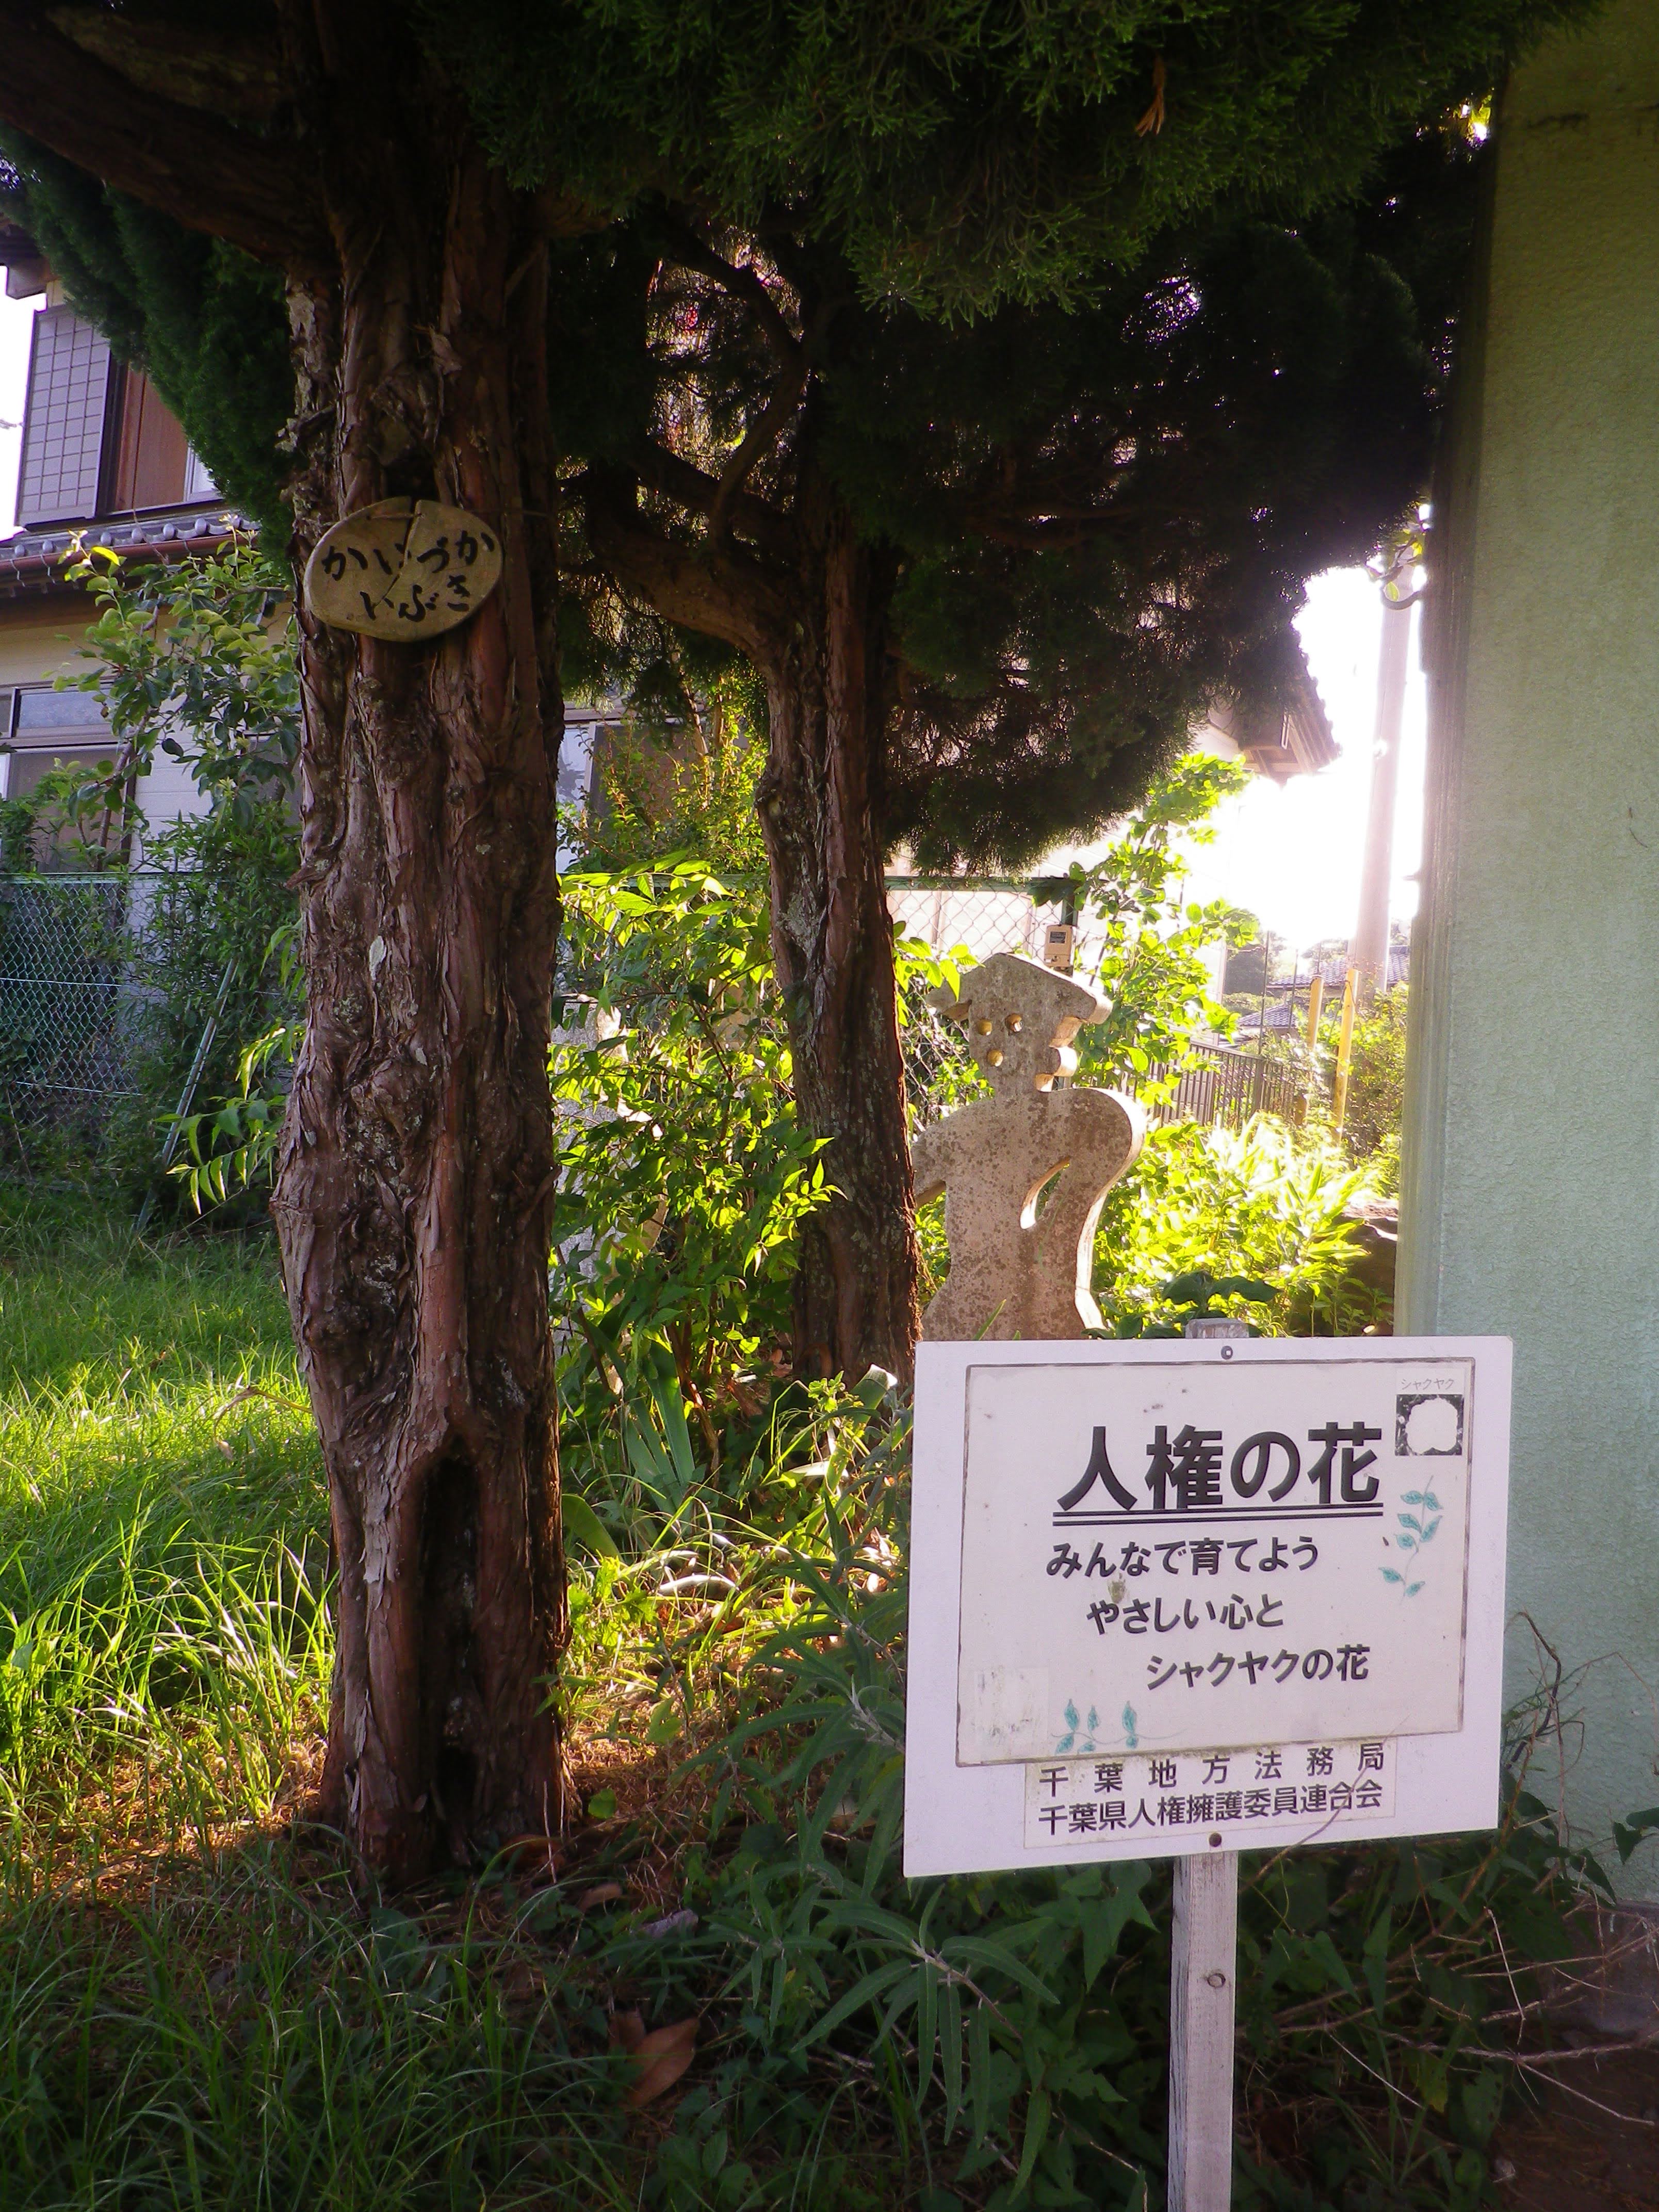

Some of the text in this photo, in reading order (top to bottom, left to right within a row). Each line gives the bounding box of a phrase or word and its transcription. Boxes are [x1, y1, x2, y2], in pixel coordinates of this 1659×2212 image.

[360, 574, 471, 622] いぶき
[1401, 1378, 1454, 1390] シャクヤク
[1057, 1421, 1383, 1510] 人権の花
[1046, 1536, 1320, 1579] みんなで育てよう
[1087, 1593, 1284, 1634] やさしい心と
[1146, 1644, 1371, 1690] シャクヤクの花
[1038, 1778, 1384, 1835] 千葉県人権擁護委員連合会
